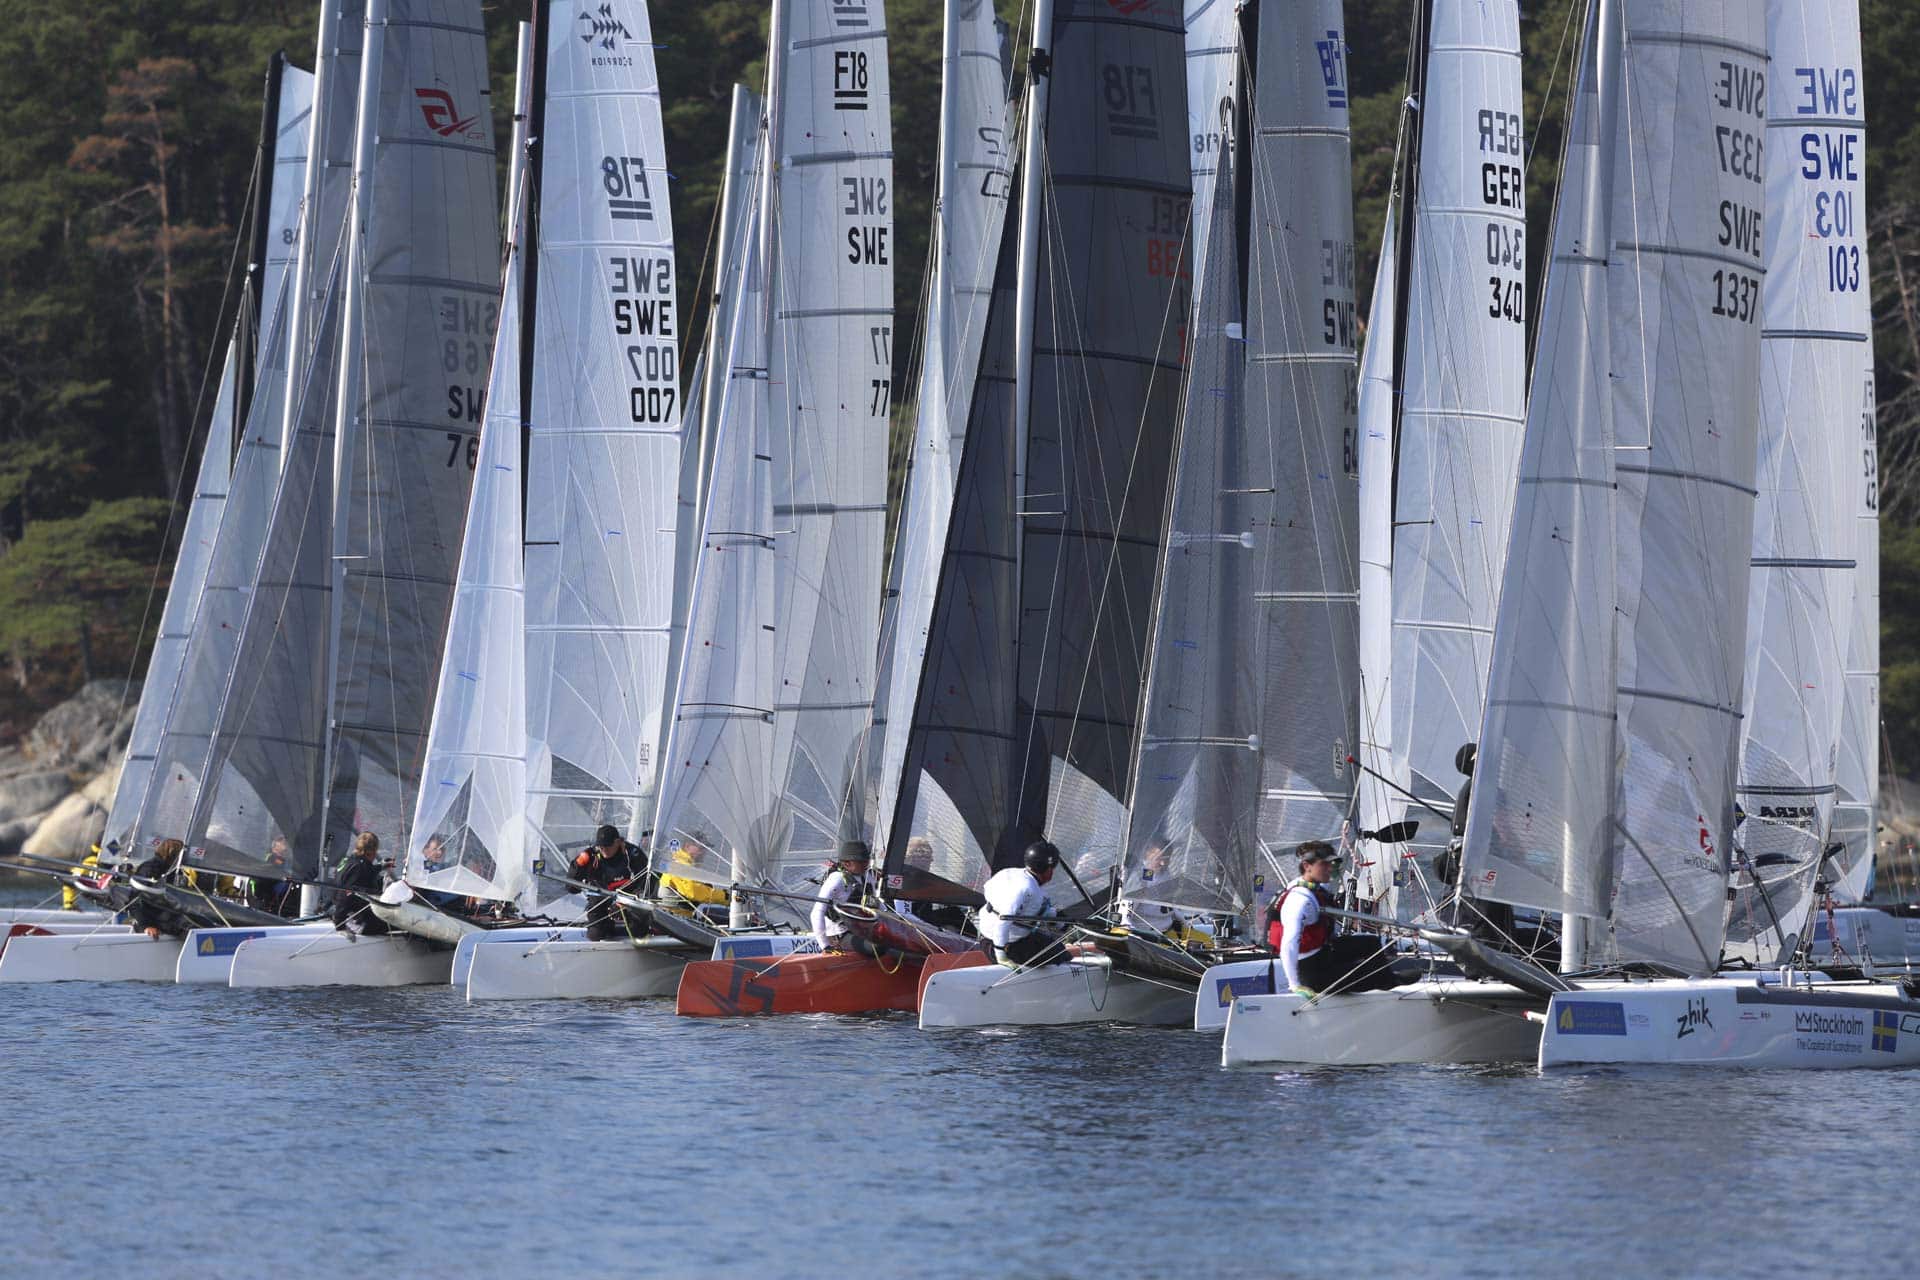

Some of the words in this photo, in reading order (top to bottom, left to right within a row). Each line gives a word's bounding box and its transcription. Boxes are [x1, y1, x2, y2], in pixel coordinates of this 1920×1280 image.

[834, 51, 868, 90] F18
[1801, 133, 1858, 181] SWE
[1482, 162, 1522, 209] GER
[848, 226, 888, 265] SWE
[1718, 200, 1761, 258] SWE
[1828, 245, 1860, 292] 103
[614, 299, 673, 335] SWE
[1489, 276, 1523, 324] 340
[1712, 269, 1759, 325] 1337
[1324, 298, 1355, 348] SWE
[631, 387, 675, 423] 007
[870, 379, 889, 417] 77
[1677, 997, 1713, 1039] zhik
[1813, 1012, 1864, 1036] Stockholm
